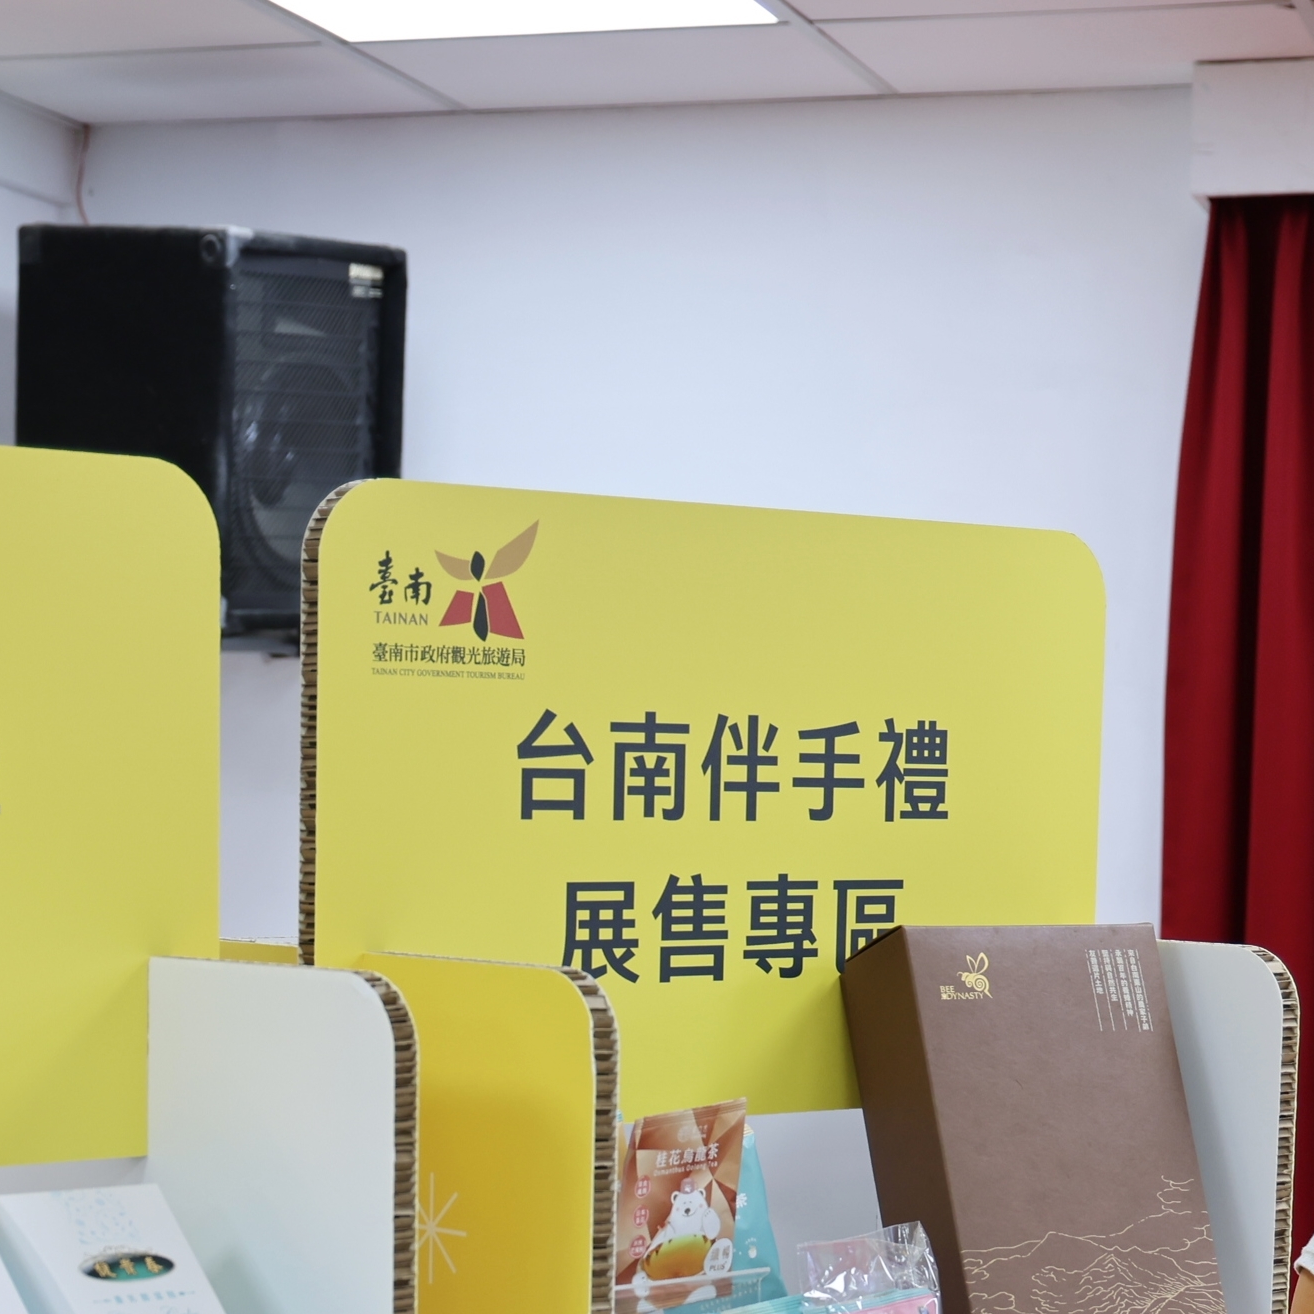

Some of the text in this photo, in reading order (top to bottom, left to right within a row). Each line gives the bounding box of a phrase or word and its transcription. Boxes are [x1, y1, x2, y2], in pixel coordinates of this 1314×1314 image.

[369, 550, 432, 605] 臺南
[373, 610, 429, 626] TAINAN
[372, 642, 526, 667] 臺南市政府觀光旅遊局
[372, 667, 526, 681] TAINAN CITY GOVERNMENT TOURISM BUREAU
[516, 708, 950, 823] 台南伴手禮
[940, 985, 955, 993] BEE
[947, 991, 984, 1001] DYNASTY
[655, 1142, 720, 1169] 桂花烏龍茶
